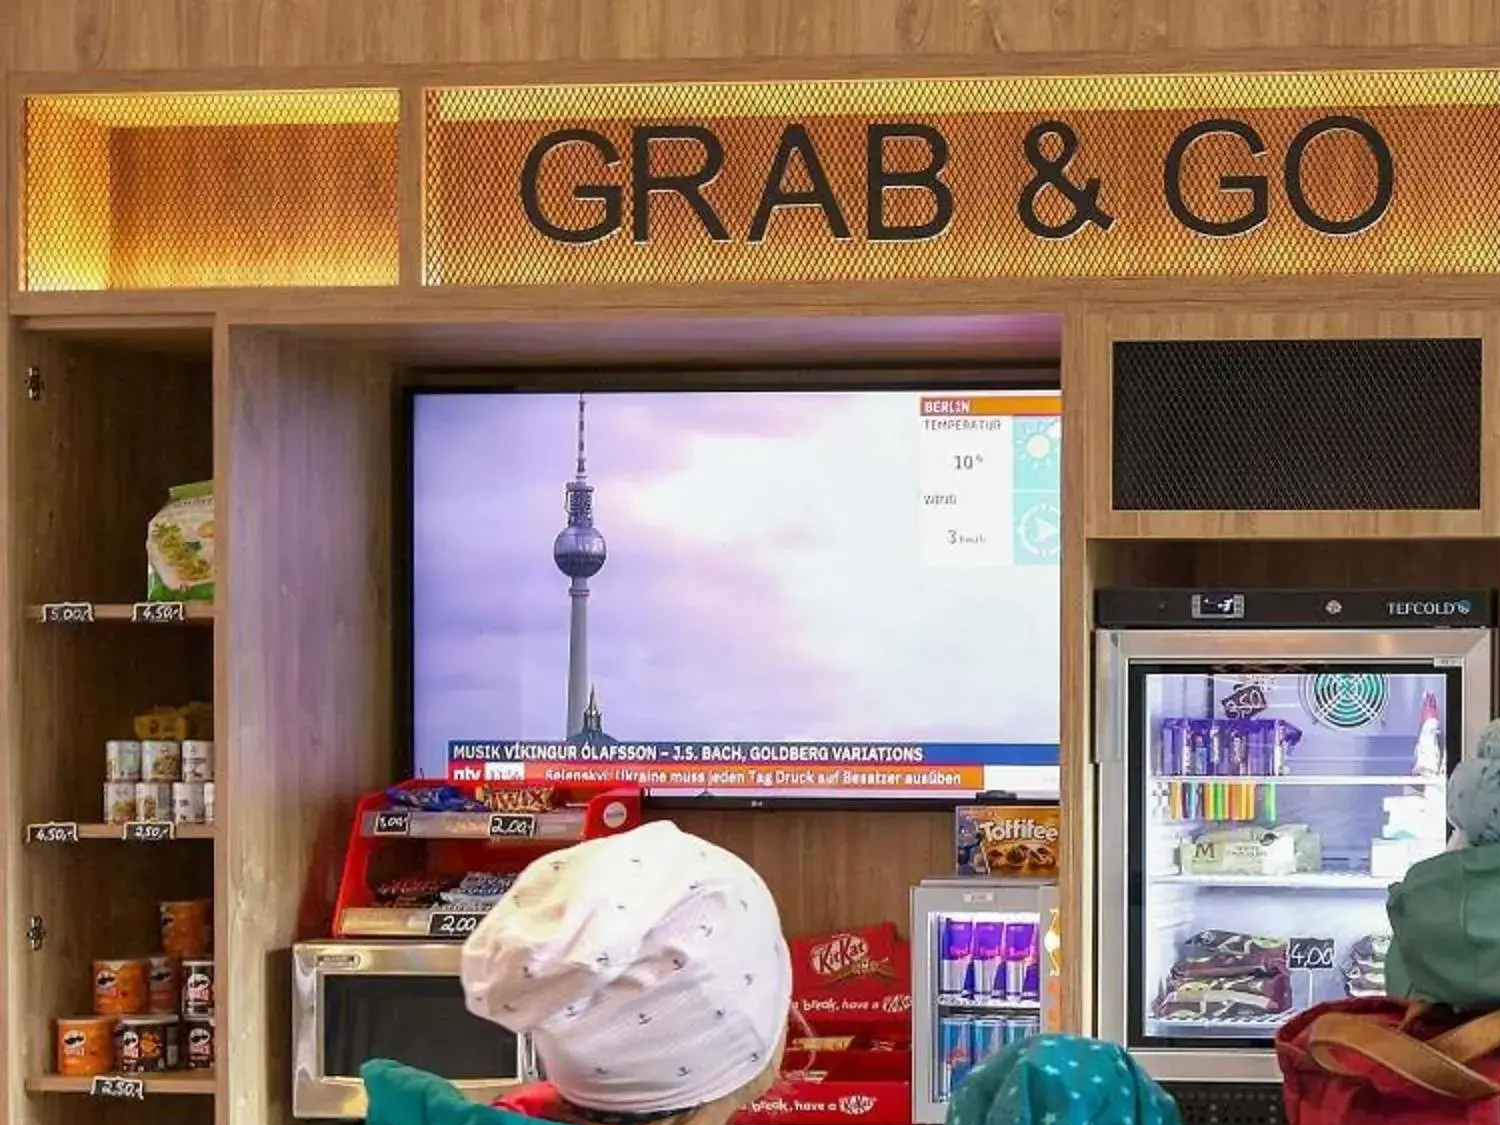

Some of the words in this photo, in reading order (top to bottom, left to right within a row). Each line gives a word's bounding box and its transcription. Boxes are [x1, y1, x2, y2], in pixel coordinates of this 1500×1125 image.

[519, 123, 954, 244] GRAB
[1017, 119, 1116, 241] &
[1163, 115, 1396, 238] GO
[924, 400, 971, 413] BERLIN
[924, 419, 1002, 431] TEMPERATUR
[947, 529, 958, 545] 3
[1387, 601, 1455, 615] TEFCOLD
[454, 745, 500, 760] MUSIK
[504, 743, 576, 760] VÍKINGUR
[581, 743, 657, 761] ÓLAFSSON
[672, 745, 699, 761] J.S.
[702, 746, 747, 763] BACH,
[750, 746, 828, 761] GOLDBERG
[832, 747, 923, 761] VARIATIONS
[615, 769, 666, 782] Ukraine
[671, 772, 705, 783] muss
[708, 770, 744, 786] jeden
[749, 770, 772, 787] Tag
[776, 770, 813, 784] Druck
[818, 770, 840, 784] auf
[844, 770, 901, 785] Besatzer
[905, 770, 961, 785] ausüben
[980, 818, 1058, 842] Toffifee
[818, 937, 866, 973] KitKat
[842, 999, 870, 1010] have
[794, 1099, 825, 1111] have
